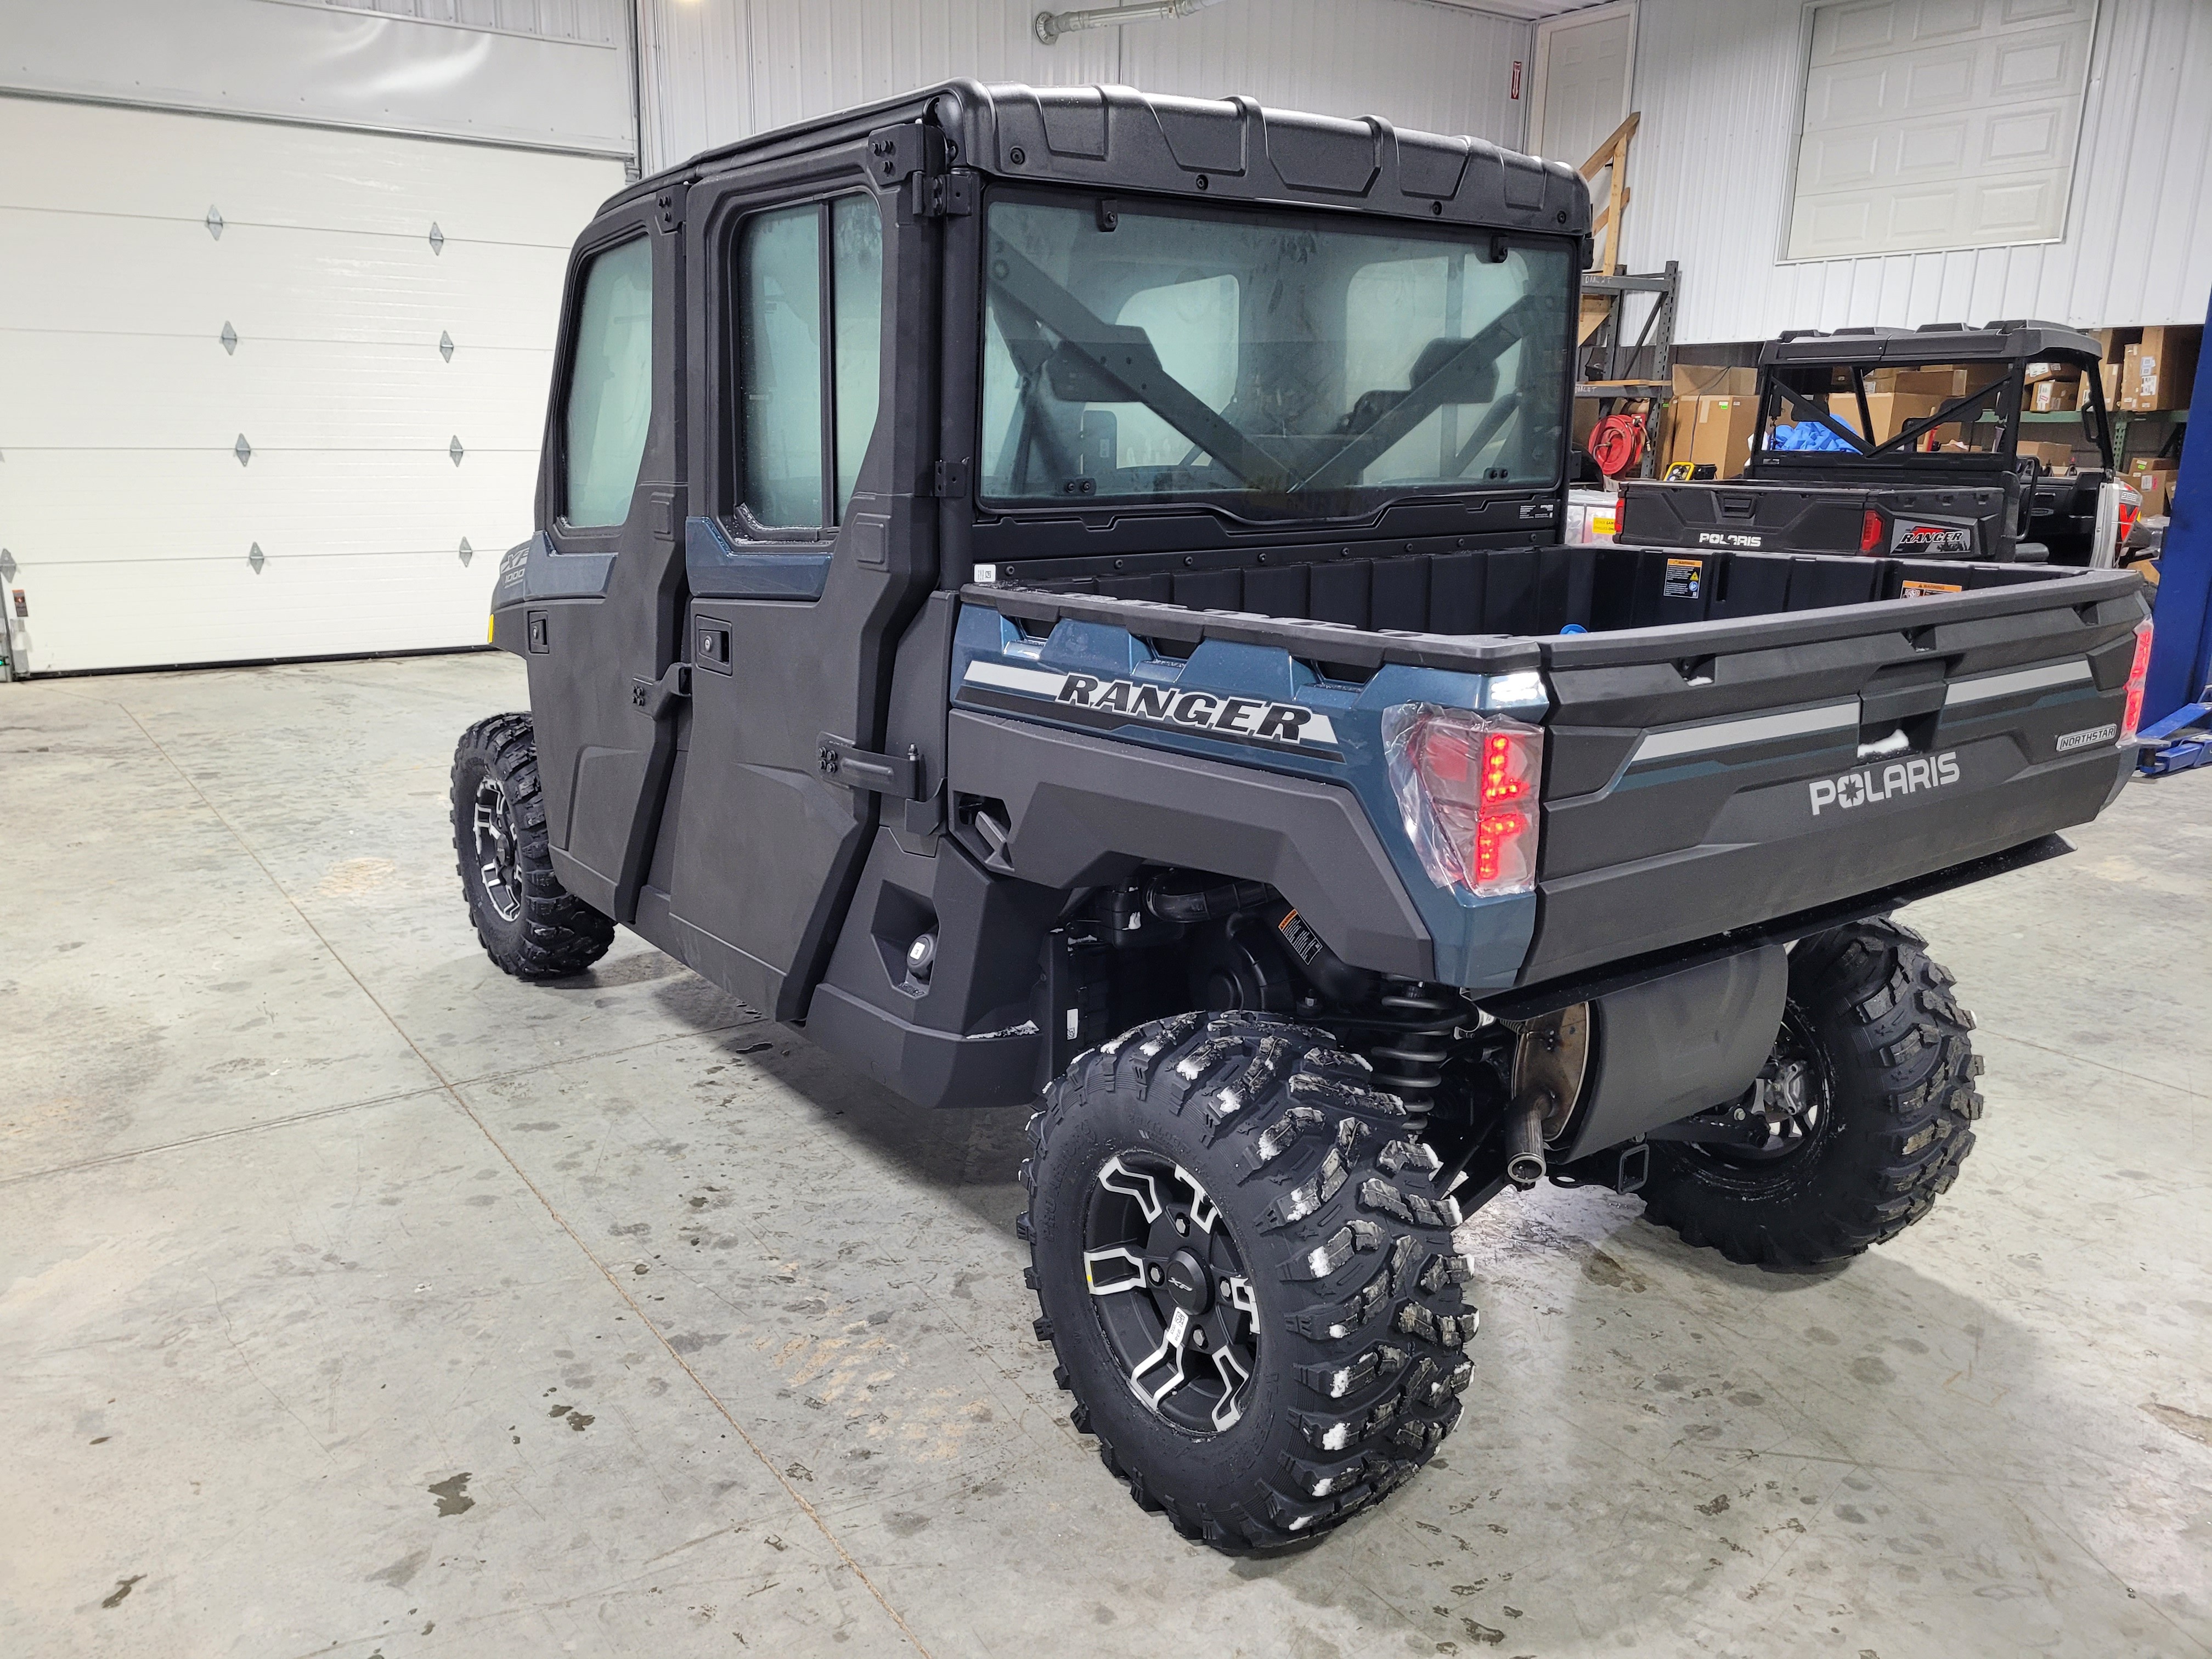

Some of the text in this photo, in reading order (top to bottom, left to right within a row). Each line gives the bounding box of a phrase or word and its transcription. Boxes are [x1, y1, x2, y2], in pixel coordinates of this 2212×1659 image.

[1699, 533, 1761, 547] POLARIS
[1900, 531, 1963, 544] RANGER
[505, 568, 526, 584] 1000
[1056, 672, 1312, 744] RANGER
[2062, 728, 2114, 747] NORTHSTAR
[1809, 752, 1960, 816] POLARIS
[1168, 1277, 1193, 1291] XP
